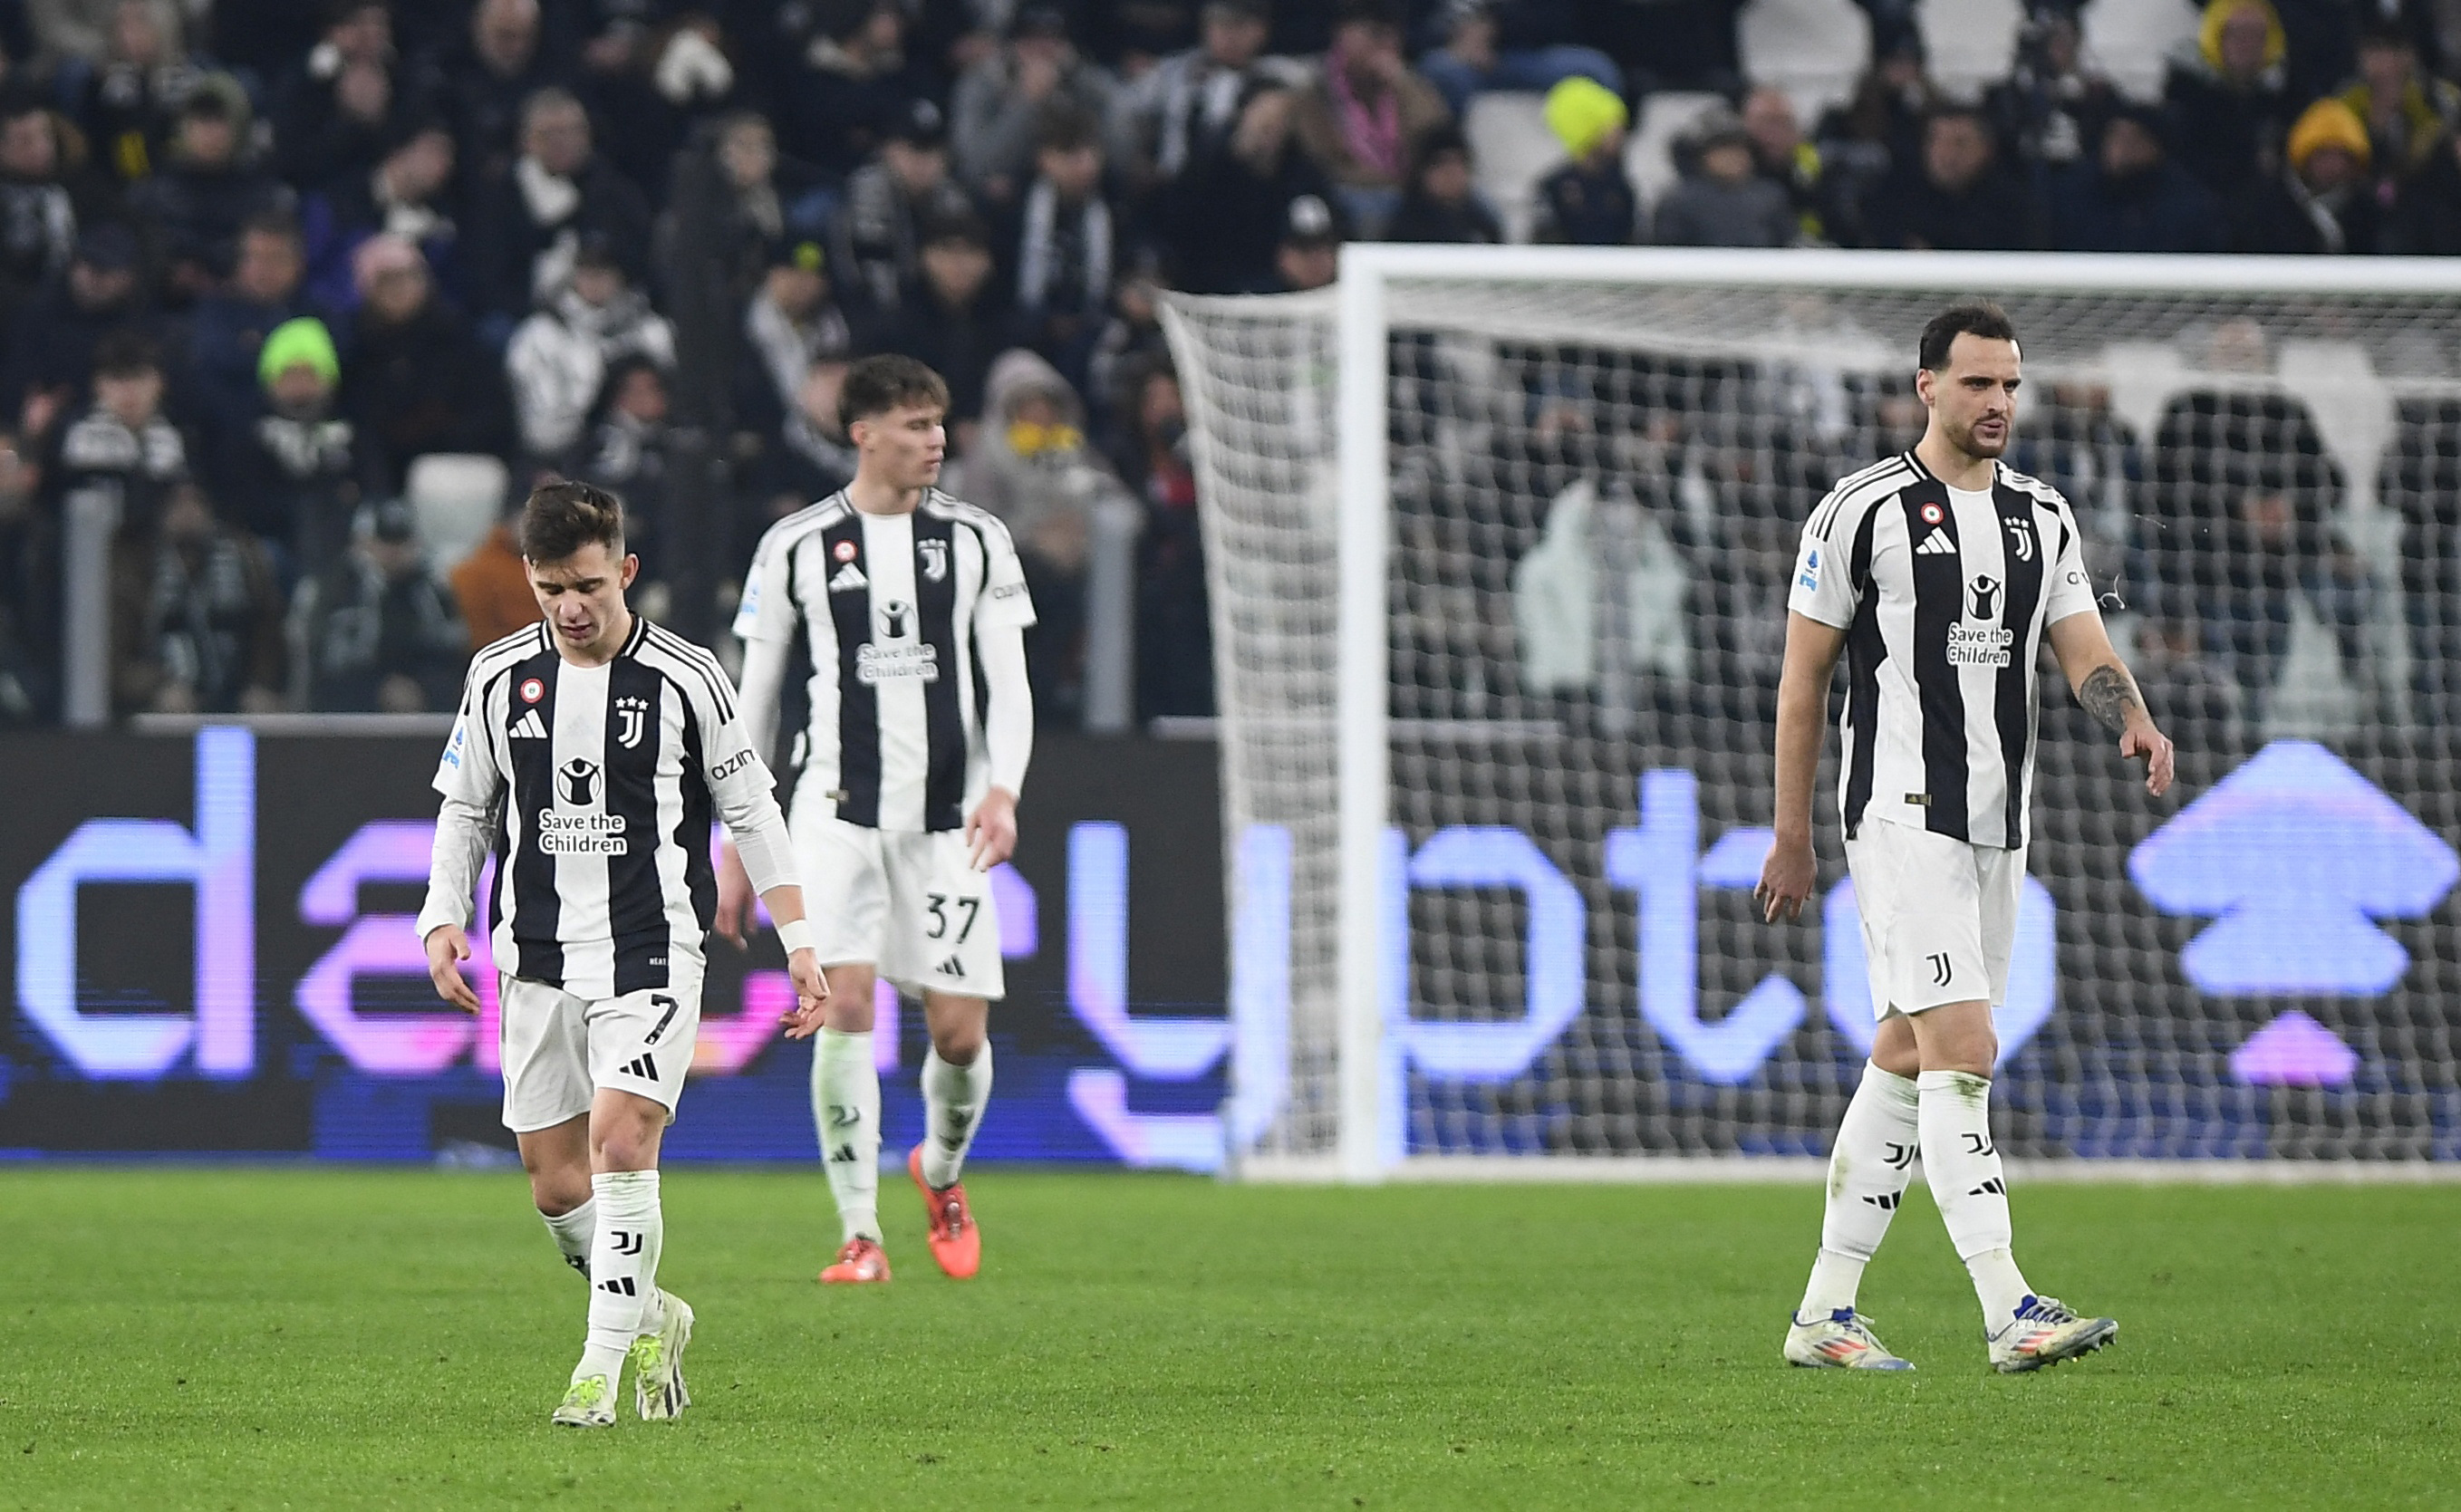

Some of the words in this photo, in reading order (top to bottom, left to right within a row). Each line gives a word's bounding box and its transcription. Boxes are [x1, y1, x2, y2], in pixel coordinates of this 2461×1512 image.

[1949, 624, 1986, 642] Save
[1990, 627, 2012, 643] the
[861, 645, 900, 660] Save
[906, 643, 934, 658] the
[1948, 646, 2008, 664] Children
[863, 662, 935, 678] Children
[542, 811, 584, 829] Save
[590, 813, 622, 830] the
[542, 833, 624, 852] Children
[926, 891, 980, 944] 37
[643, 993, 680, 1045] 7
